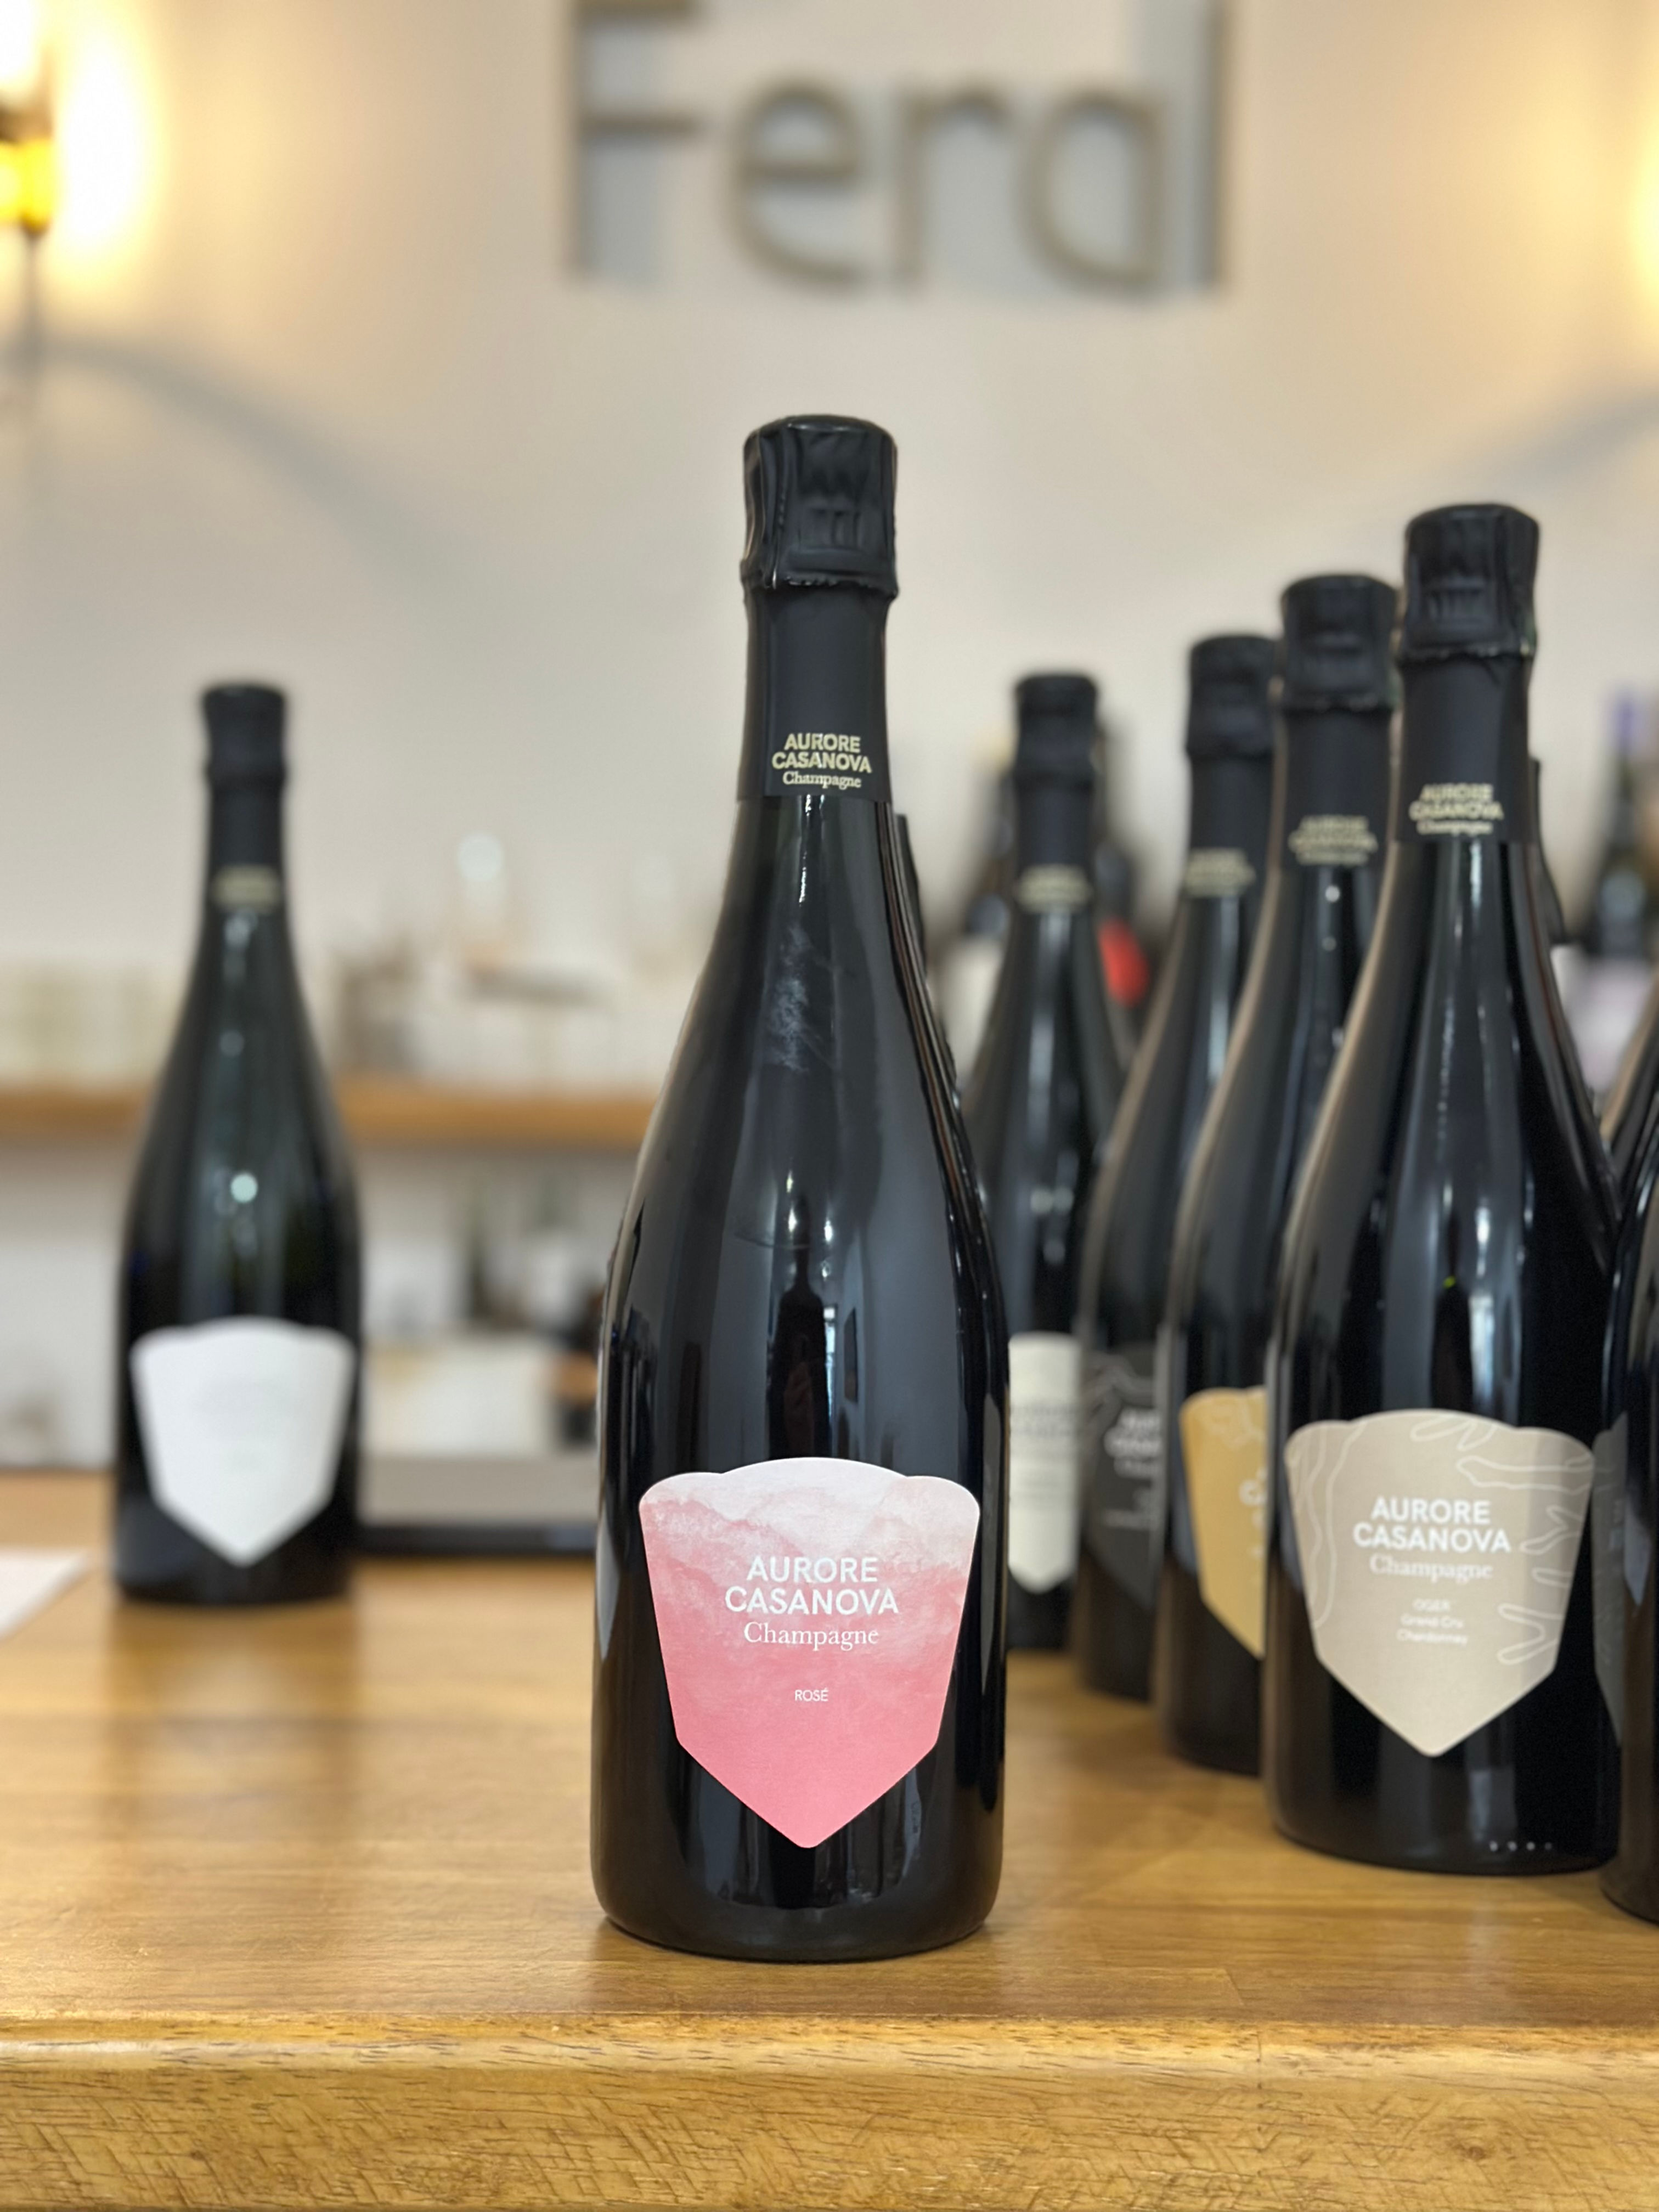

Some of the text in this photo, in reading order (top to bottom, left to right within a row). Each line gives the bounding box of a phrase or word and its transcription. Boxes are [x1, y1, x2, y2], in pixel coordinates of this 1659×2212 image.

[783, 732, 861, 753] AURORE
[771, 751, 872, 774] CASANOVA
[782, 770, 861, 790] Champagne
[1371, 1496, 1491, 1525] AURORE
[1352, 1521, 1511, 1553] CASANOVA
[746, 1555, 878, 1583] AURORE
[1369, 1553, 1493, 1584] Champagne
[725, 1585, 899, 1615] CASANOVA
[743, 1621, 879, 1652] Champagne
[794, 1687, 829, 1702] ROSÉ
